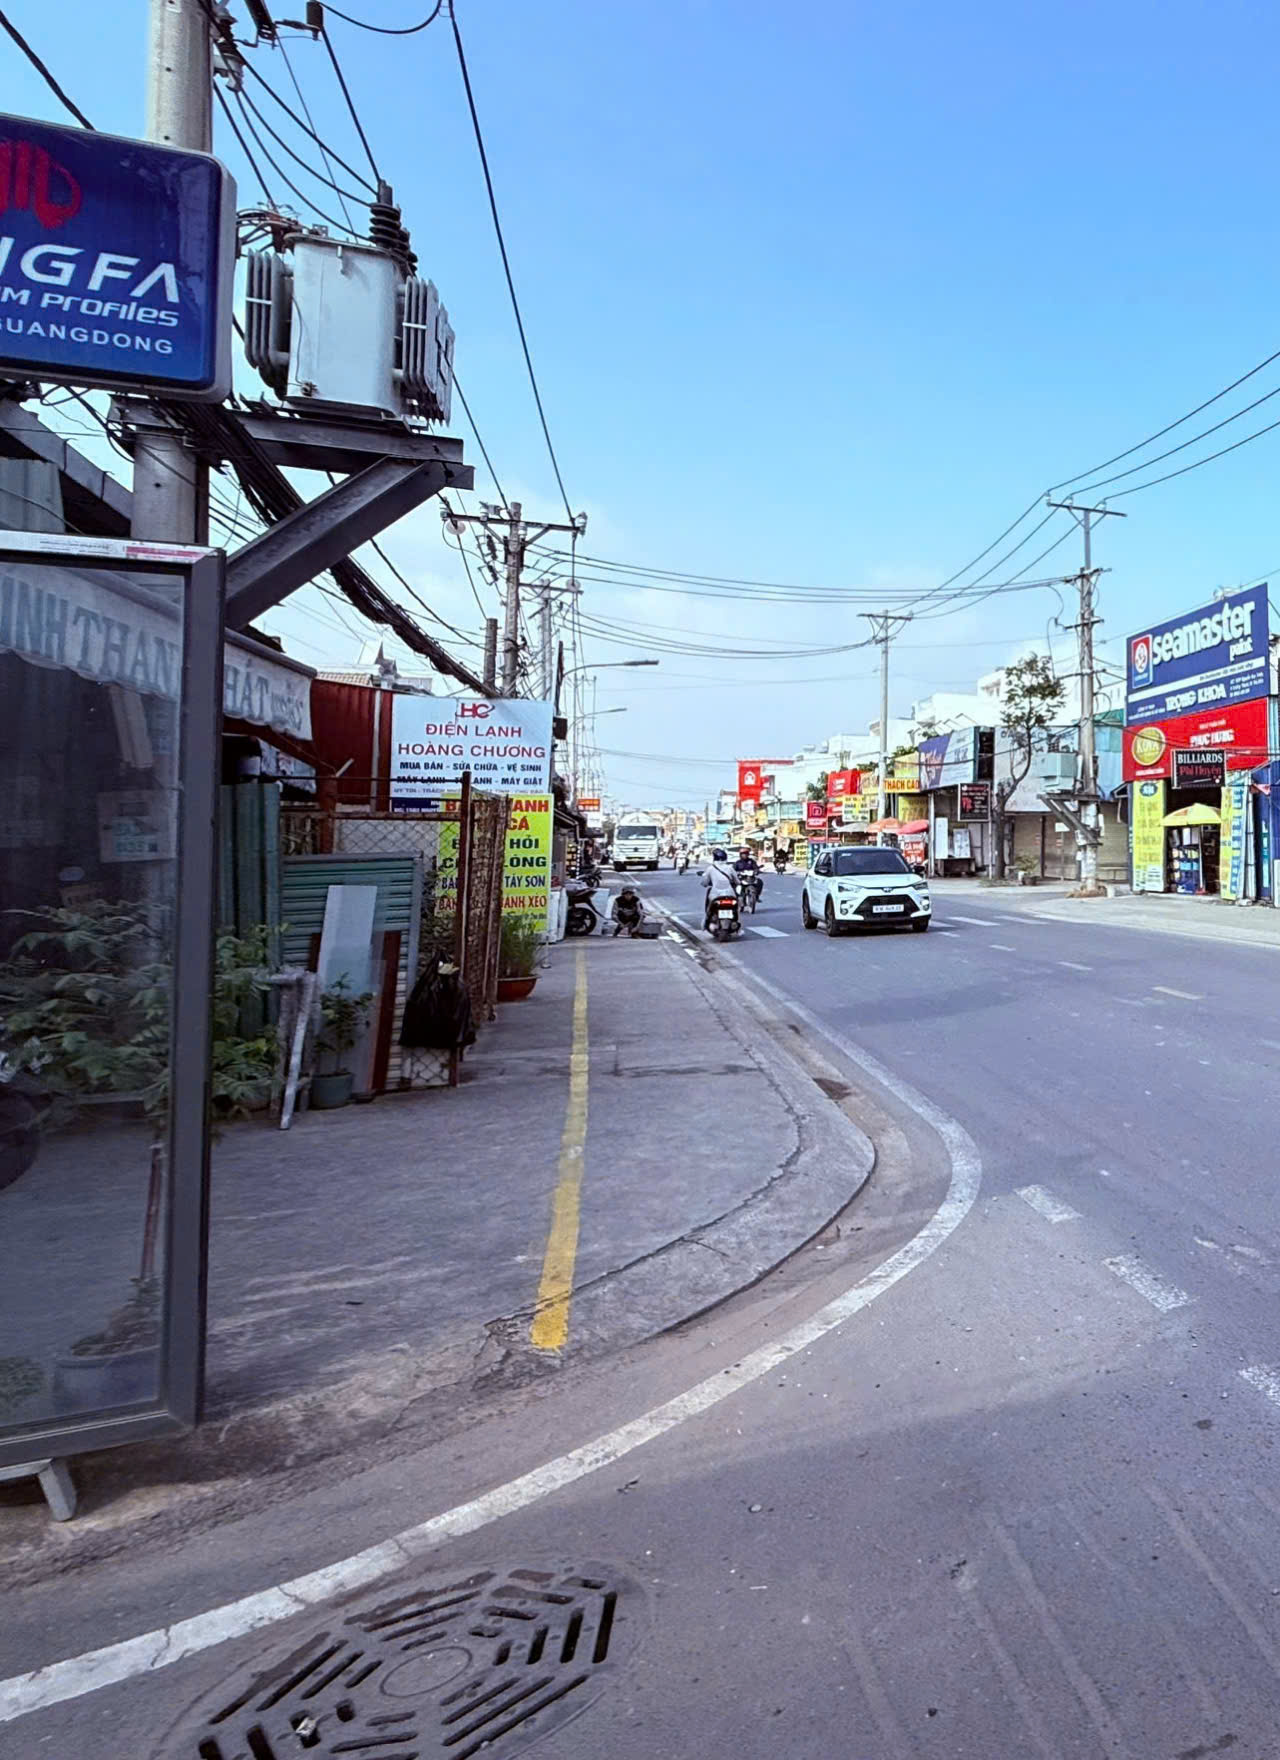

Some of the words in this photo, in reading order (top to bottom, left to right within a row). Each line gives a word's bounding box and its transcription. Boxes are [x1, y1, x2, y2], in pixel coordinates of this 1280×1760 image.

[0, 236, 180, 304] GFA
[0, 286, 31, 306] M
[0, 317, 174, 355] UANGDONG
[1152, 601, 1256, 666] seamaster
[73, 606, 181, 698] THAN
[225, 659, 270, 719] HÁT
[425, 721, 468, 738] ĐIỆN
[475, 725, 522, 740] LẠNH
[398, 740, 464, 757] HOÀNG
[470, 743, 546, 758] CHƯƠNG
[1177, 752, 1223, 764] BILLIARDS
[400, 761, 421, 770] MUA
[423, 760, 443, 770] BÁN
[452, 760, 471, 770] SỬA
[473, 762, 498, 771] CHỮA
[507, 763, 517, 773] VỆ
[520, 764, 542, 772] SINH
[501, 775, 520, 785] MÁY
[512, 799, 549, 813] ANH
[510, 834, 539, 849] HỎI
